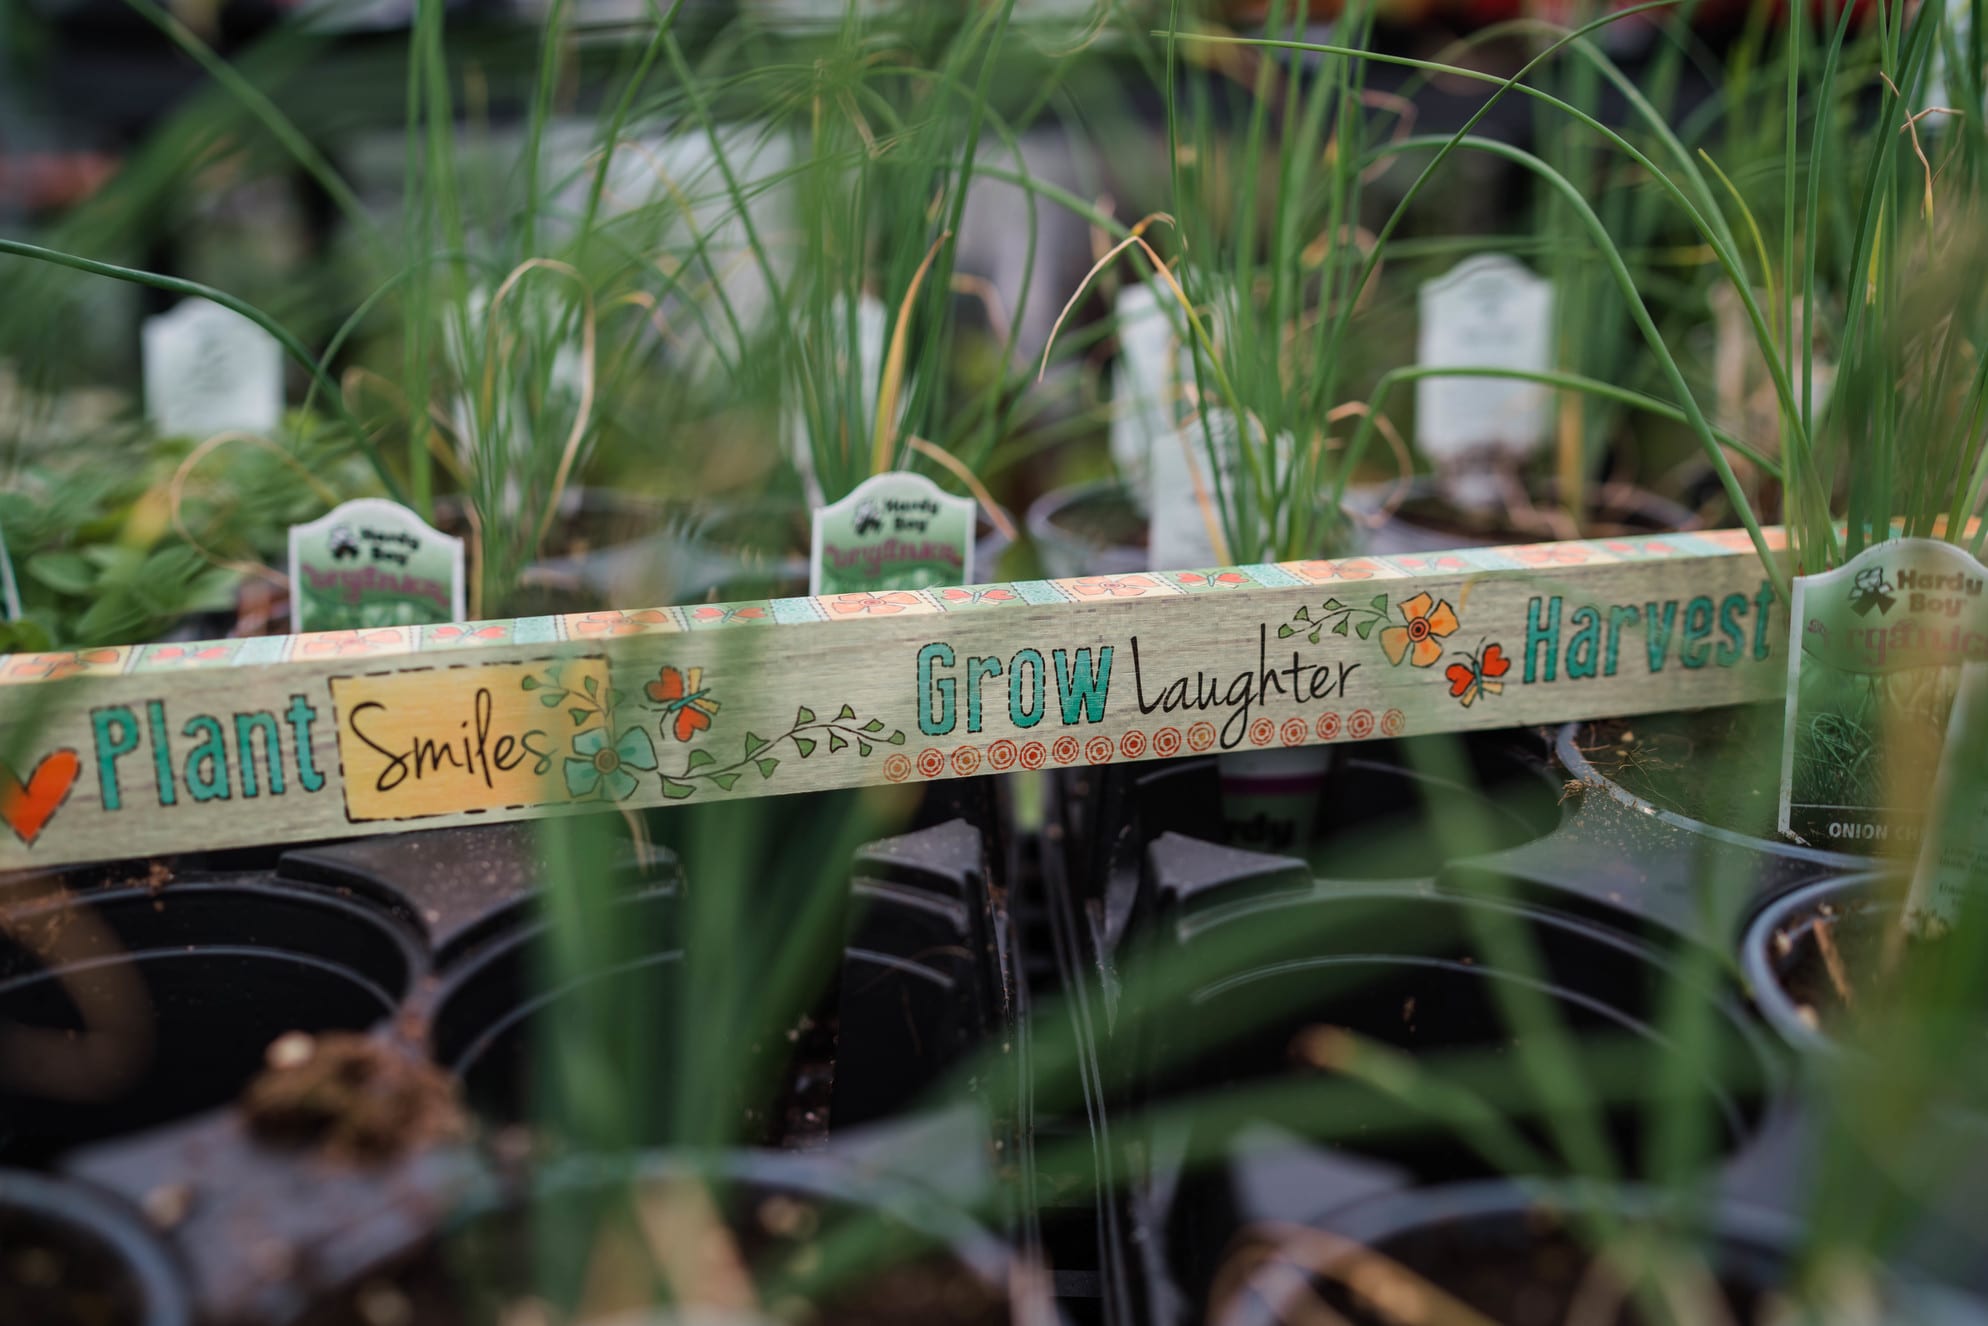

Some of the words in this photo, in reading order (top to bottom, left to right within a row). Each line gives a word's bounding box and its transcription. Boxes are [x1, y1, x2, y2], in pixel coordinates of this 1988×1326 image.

[1897, 569, 1984, 596] Hardy
[1909, 592, 1965, 618] Boy
[89, 693, 327, 812] Plant
[349, 687, 558, 792] Smiles
[916, 642, 1115, 737] Grow
[1130, 622, 1362, 750] Laughter
[1522, 579, 1776, 685] Harvest
[1828, 822, 1889, 840] ONION
